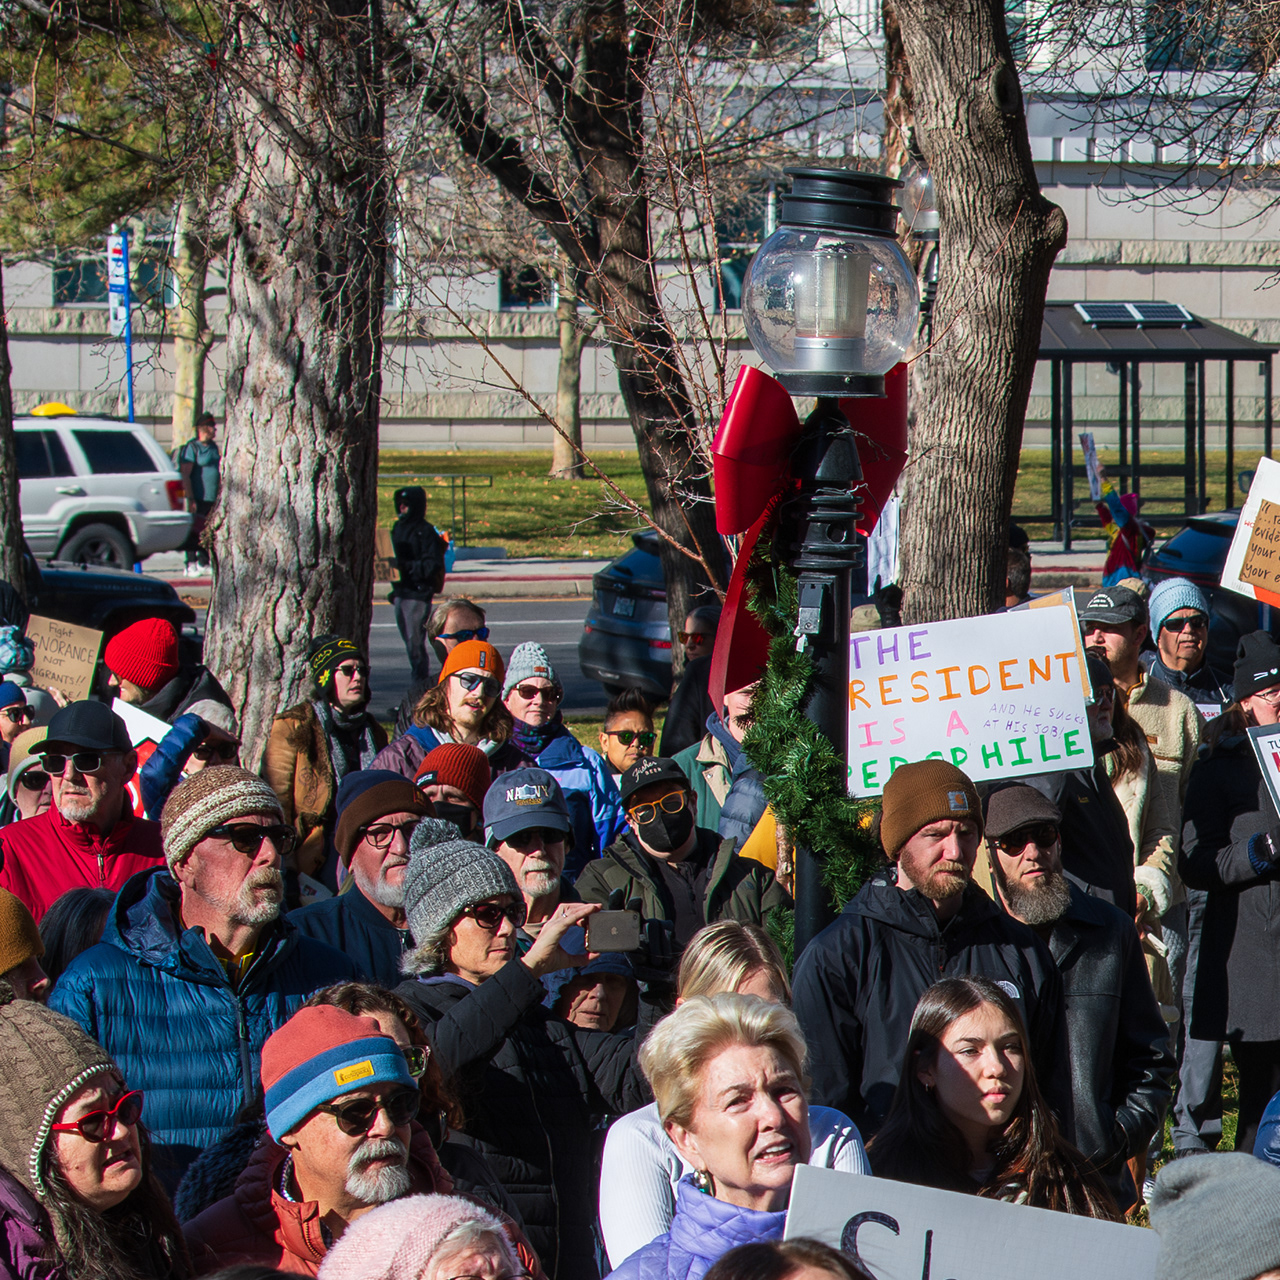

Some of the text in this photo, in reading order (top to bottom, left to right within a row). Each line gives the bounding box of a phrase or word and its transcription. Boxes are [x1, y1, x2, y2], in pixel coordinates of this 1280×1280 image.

[1250, 543, 1276, 562] your
[1242, 563, 1272, 580] your
[48, 621, 74, 638] Fight
[850, 630, 932, 670] THE
[43, 655, 65, 666] NOT
[989, 703, 1016, 716] AND
[1023, 705, 1042, 717] HE
[858, 710, 969, 748] IS A
[983, 719, 1065, 739] AT HIS JOB!
[505, 784, 549, 803] NAVY
